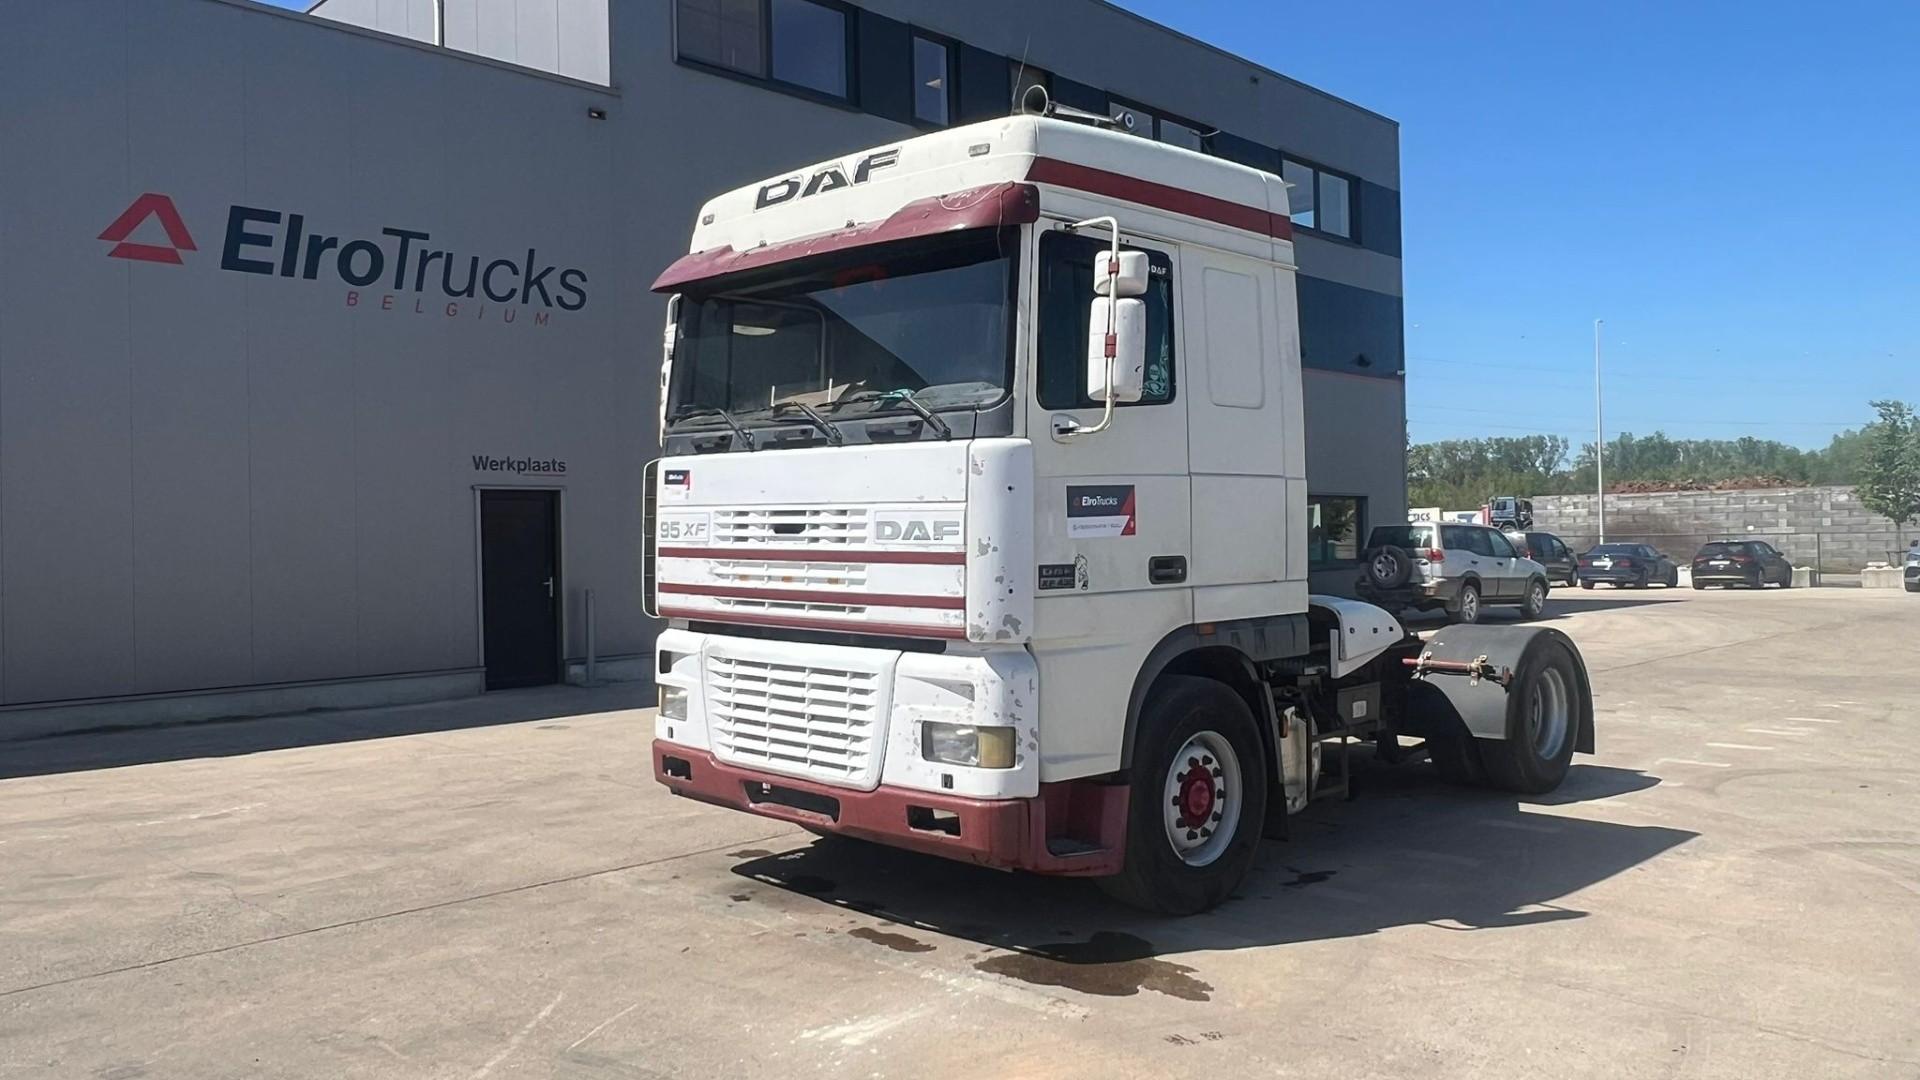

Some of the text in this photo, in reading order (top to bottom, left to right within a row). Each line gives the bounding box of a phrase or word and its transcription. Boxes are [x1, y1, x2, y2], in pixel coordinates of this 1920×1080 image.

[754, 147, 902, 211] DAF
[220, 205, 588, 311] ElroTrucks
[346, 291, 550, 326] BELGIUM
[472, 455, 566, 474] Werkplaats
[1082, 496, 1118, 506] ElroTrucks
[660, 521, 707, 539] 95 XF
[876, 520, 960, 541] DAF
